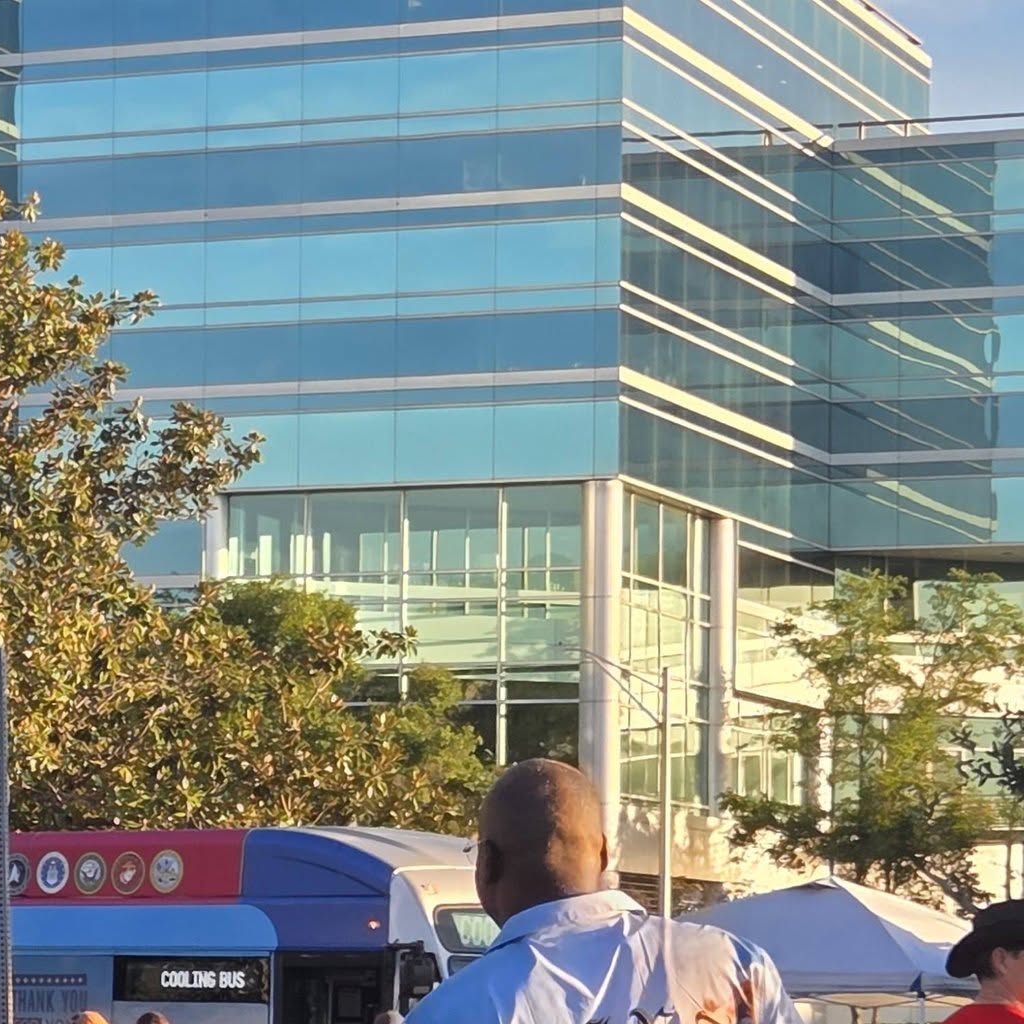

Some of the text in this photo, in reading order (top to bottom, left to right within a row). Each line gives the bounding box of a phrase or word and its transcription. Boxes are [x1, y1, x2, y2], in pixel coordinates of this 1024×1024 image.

[161, 970, 246, 988] COOLING BUS
[61, 990, 88, 1012] YOU
